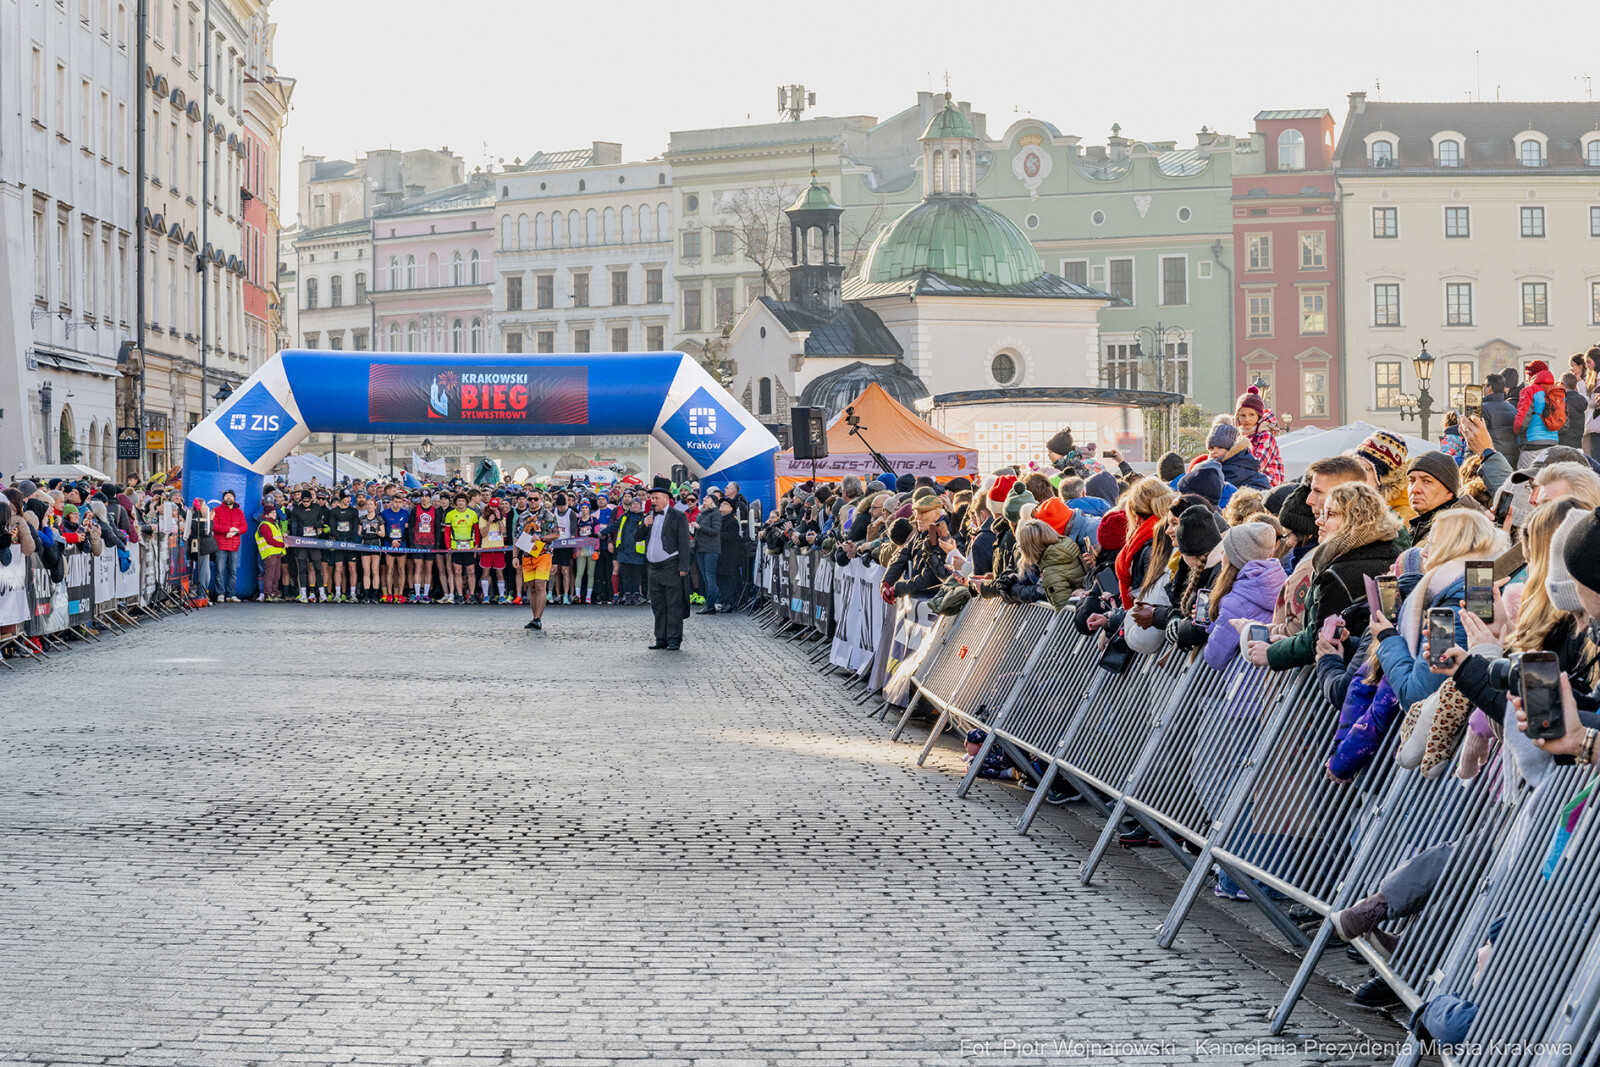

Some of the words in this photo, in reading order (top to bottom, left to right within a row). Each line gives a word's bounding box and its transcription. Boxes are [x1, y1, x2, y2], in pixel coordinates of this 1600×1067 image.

[461, 373, 528, 384] KRAKOWSKI
[461, 384, 528, 410] BIEG
[461, 410, 527, 419] SYLWESTROWY
[250, 414, 280, 431] ZIS
[686, 440, 722, 450] Kraków
